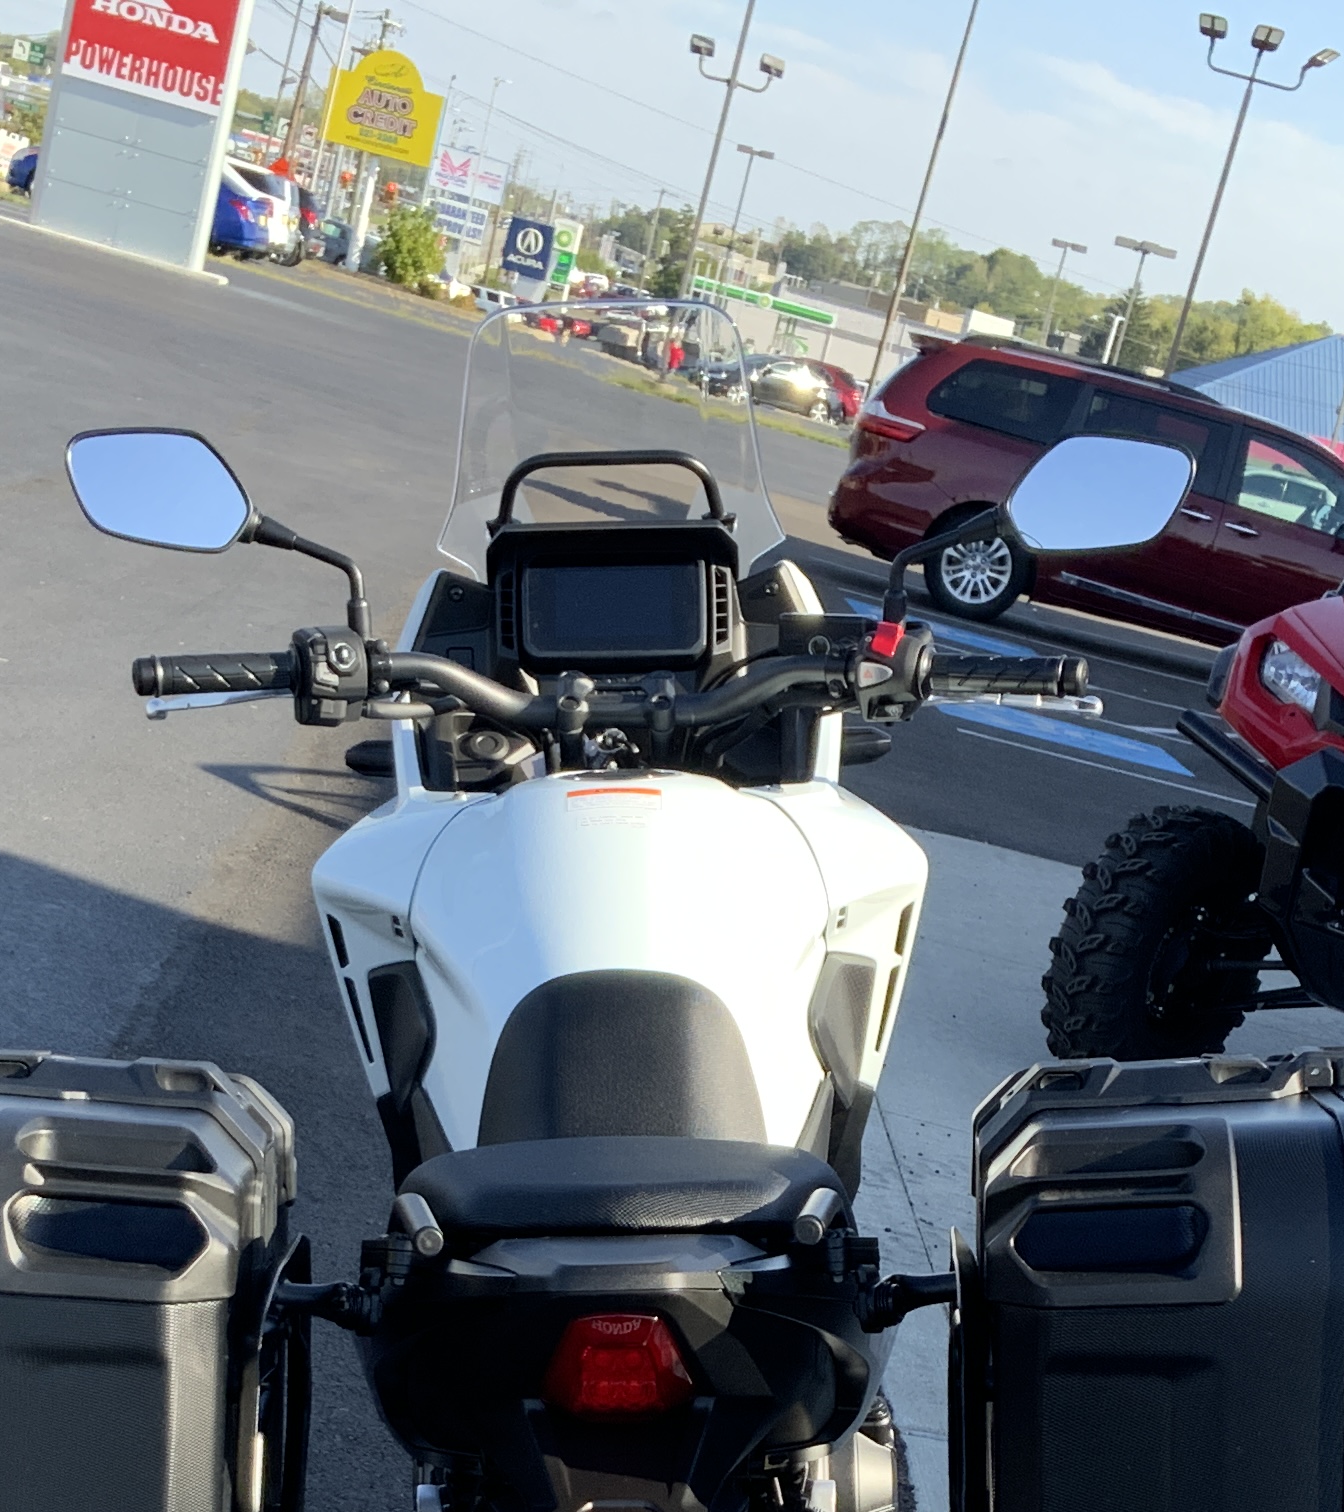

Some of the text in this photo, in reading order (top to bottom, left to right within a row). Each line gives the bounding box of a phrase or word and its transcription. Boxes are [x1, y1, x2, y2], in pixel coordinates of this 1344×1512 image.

[91, 0, 220, 44] HONDA
[64, 38, 225, 106] POWERHOUSE
[356, 86, 414, 116] AUTO
[347, 104, 419, 139] CREDIT
[506, 253, 544, 270] ACURA
